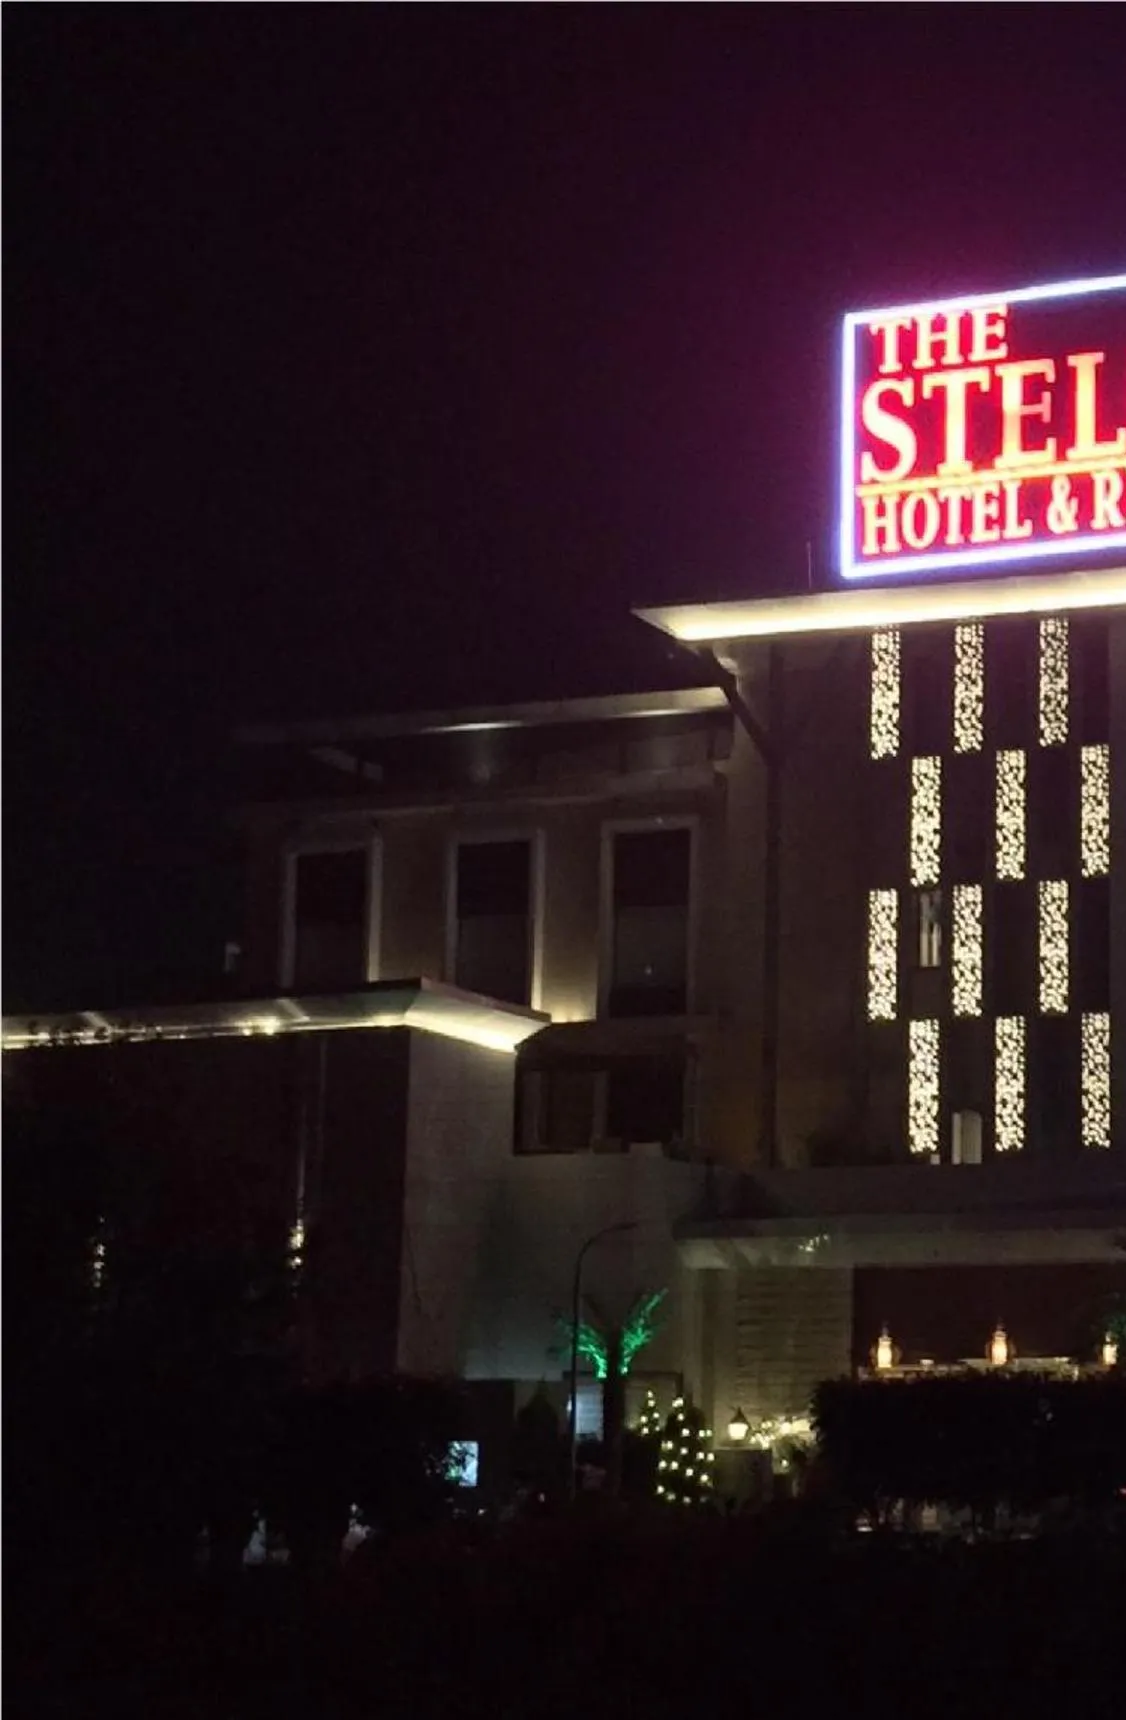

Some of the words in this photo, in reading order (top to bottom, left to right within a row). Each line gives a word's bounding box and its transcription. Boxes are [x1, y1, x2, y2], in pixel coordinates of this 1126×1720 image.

[870, 304, 1009, 374] THE
[862, 481, 1033, 555] HOTEL
[1047, 474, 1079, 534] &
